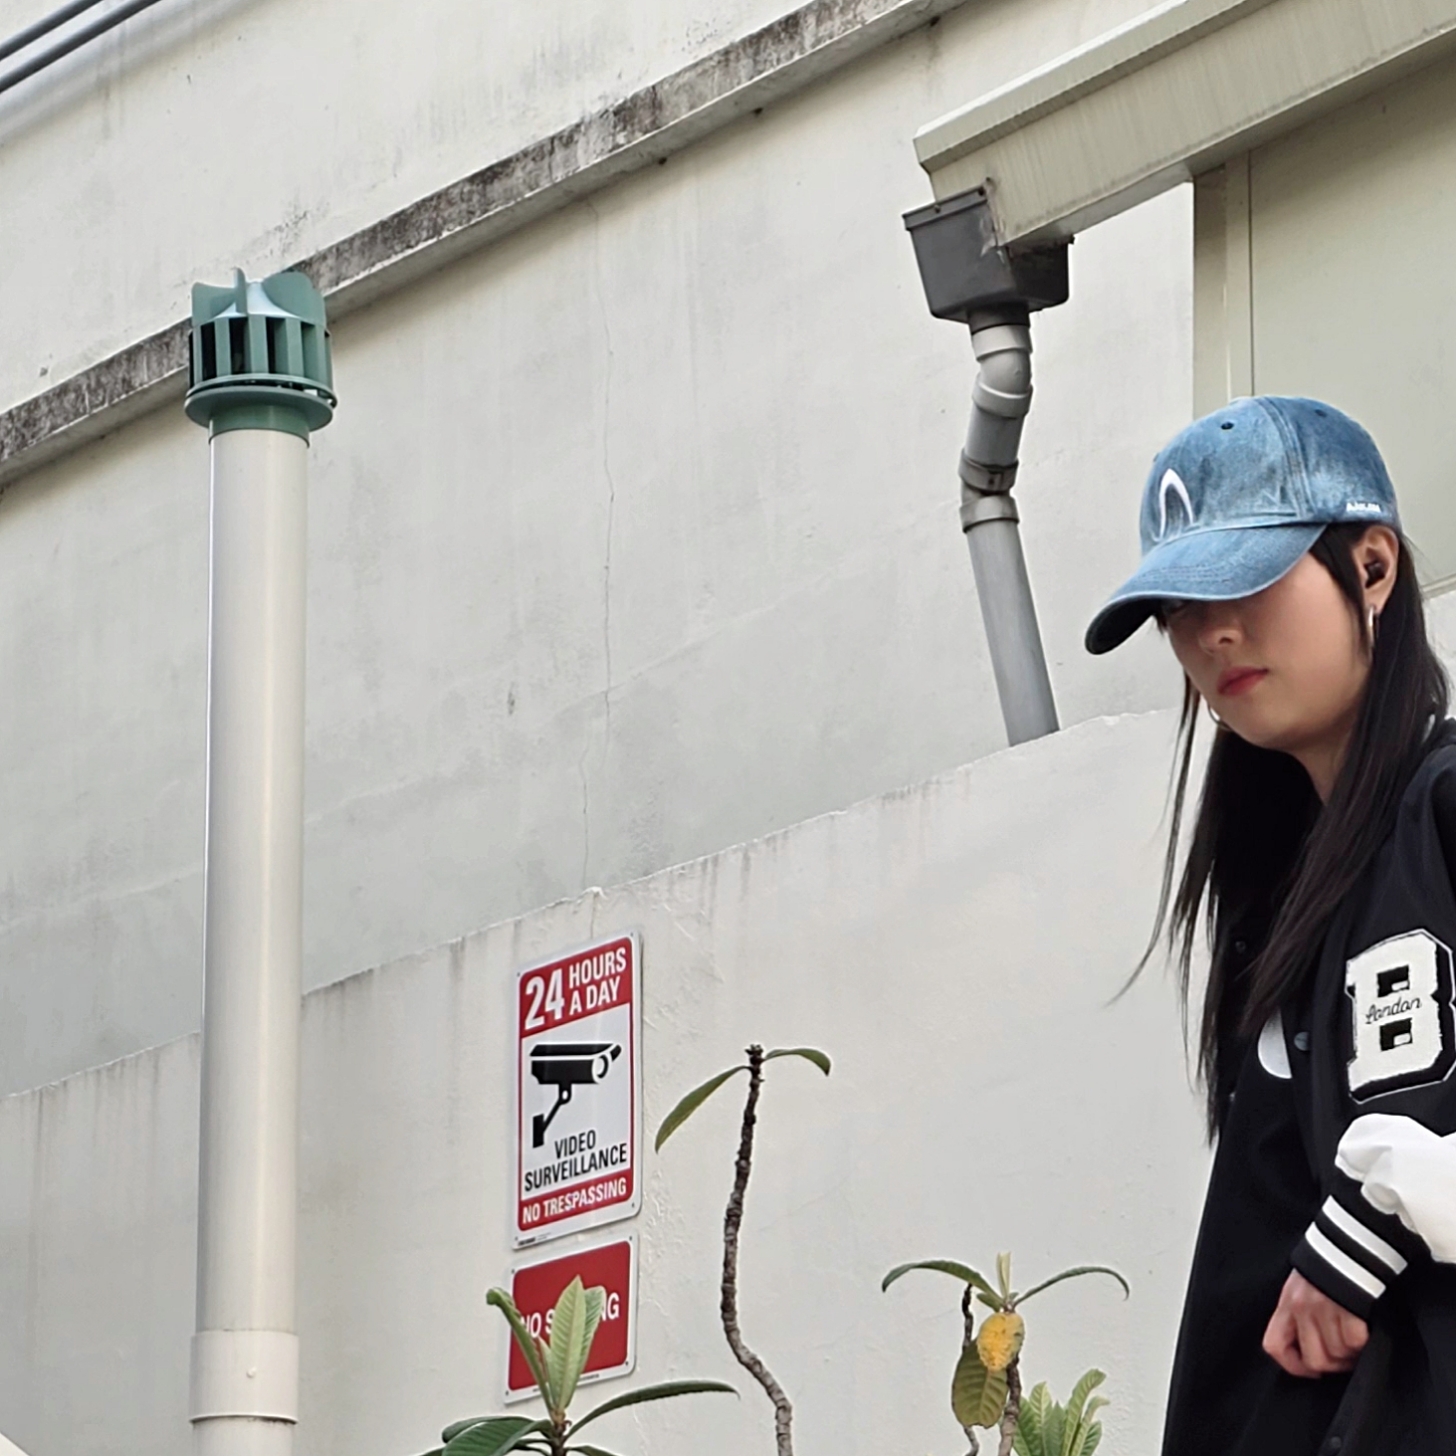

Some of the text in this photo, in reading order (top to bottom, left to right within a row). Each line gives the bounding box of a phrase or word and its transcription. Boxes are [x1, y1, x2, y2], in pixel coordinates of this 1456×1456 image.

[569, 947, 627, 989] HOURS
[525, 968, 565, 1030] 24
[569, 975, 620, 1016] A DAY
[554, 1129, 596, 1159] VIDEO
[524, 1142, 627, 1192] SURVEILLANCE
[522, 1177, 627, 1224] NO TRESPASSING
